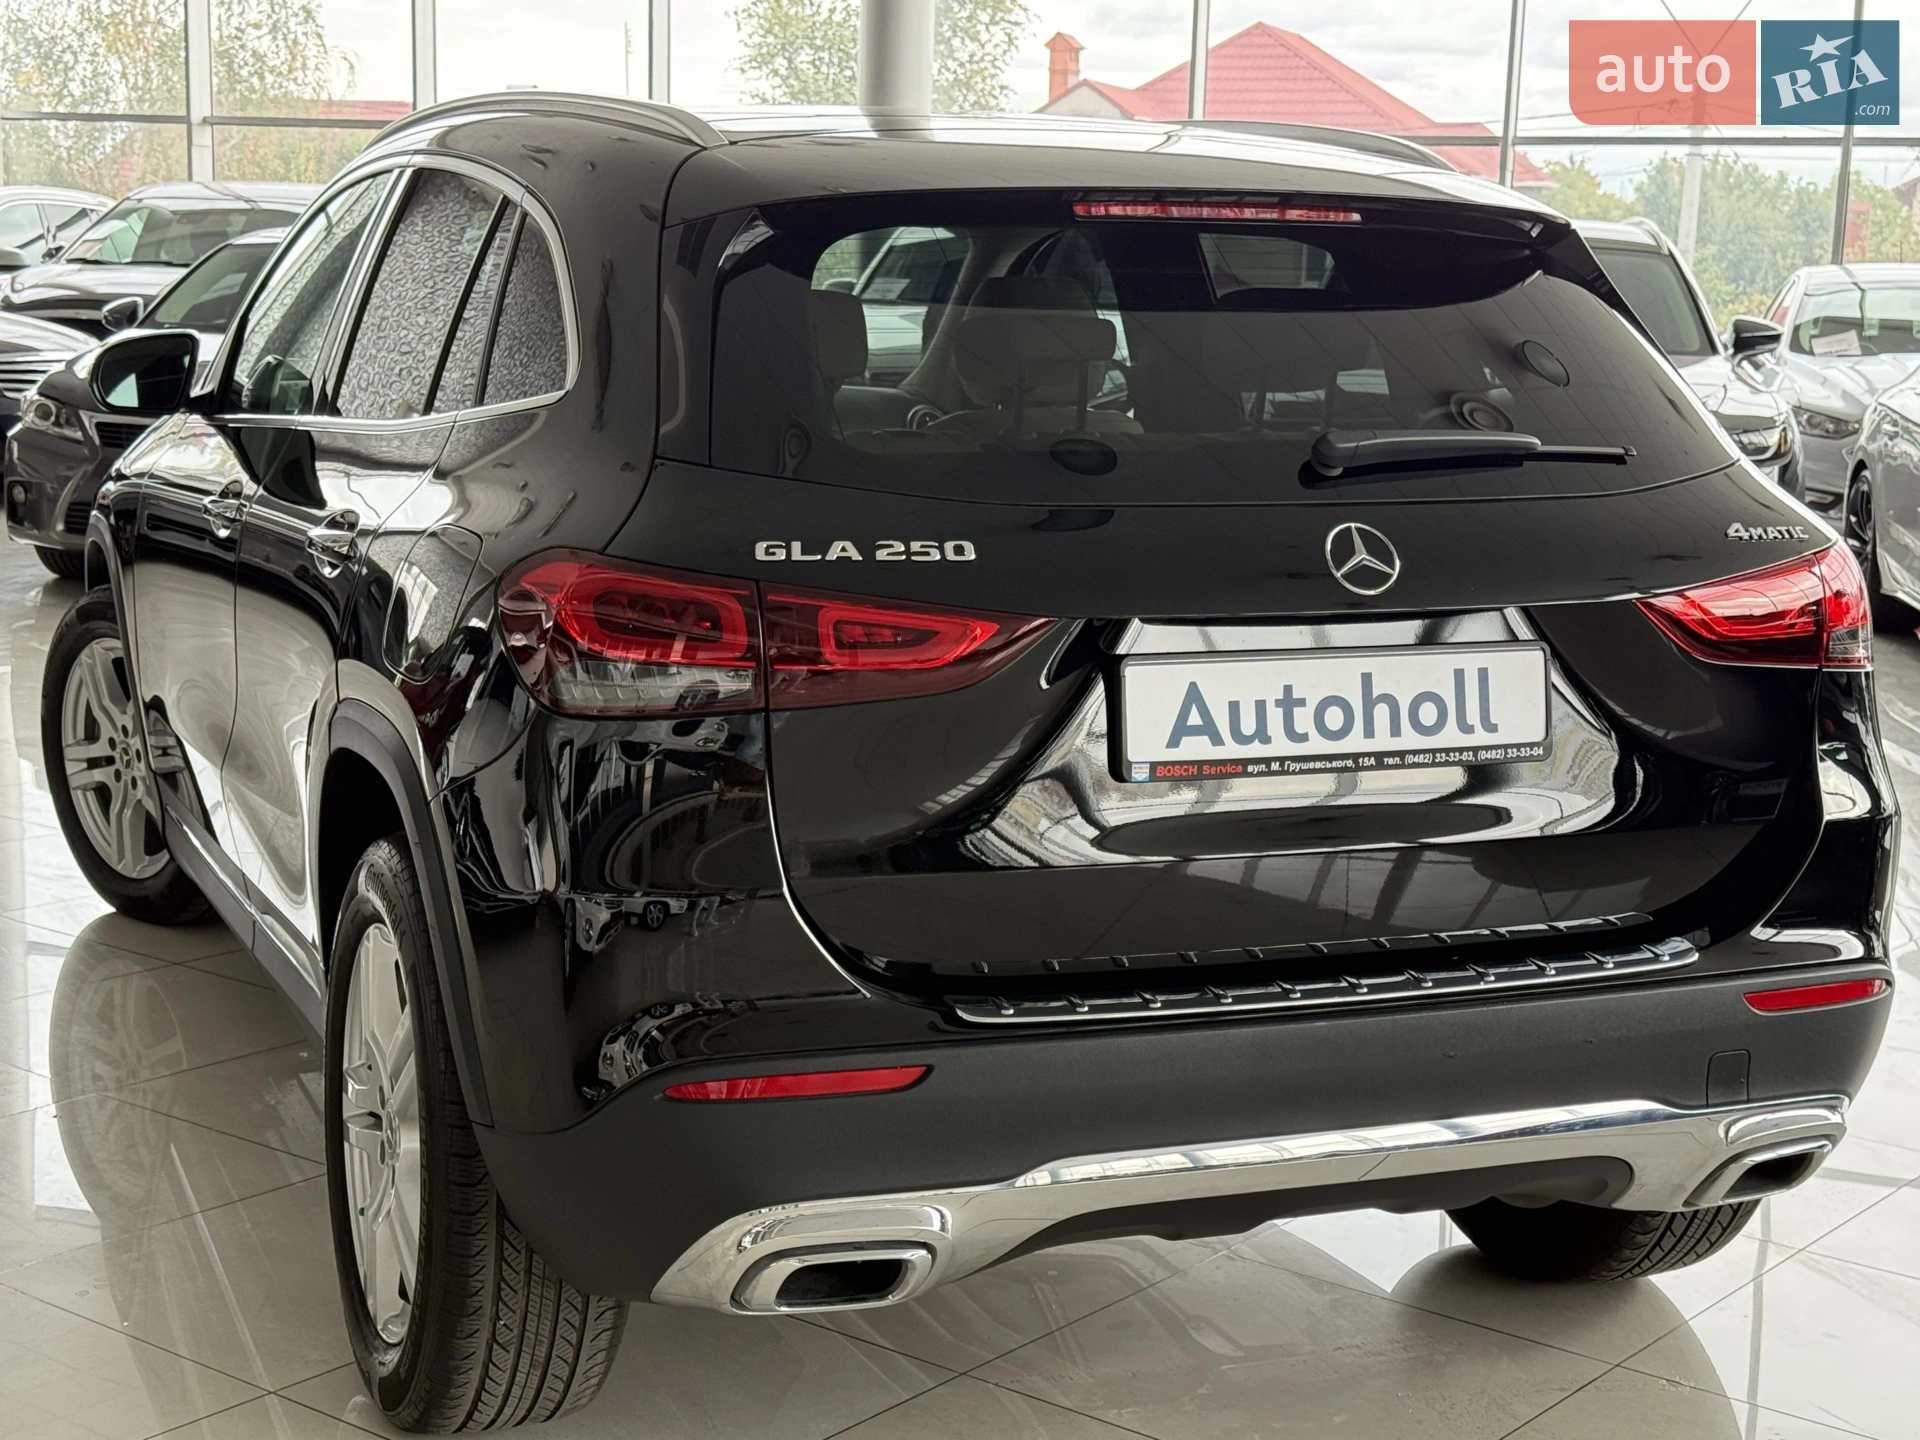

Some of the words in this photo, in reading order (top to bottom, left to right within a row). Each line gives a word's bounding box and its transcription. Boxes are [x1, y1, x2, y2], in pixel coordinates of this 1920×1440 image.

[1725, 522, 1810, 540] 4MATIC
[755, 540, 863, 561] GLA
[875, 540, 977, 561] 250
[1165, 666, 1499, 750] Autoholl
[1247, 763, 1269, 773] вул.
[1284, 758, 1355, 772] Грушевського,
[1383, 756, 1402, 766] тел.
[1404, 754, 1433, 765] (0482)
[1434, 751, 1476, 763] 33-33-03,
[1477, 749, 1505, 761] (0482)
[1506, 746, 1544, 758] 33-33-04
[1155, 765, 1198, 777] BOSCH
[1202, 764, 1243, 775] Service
